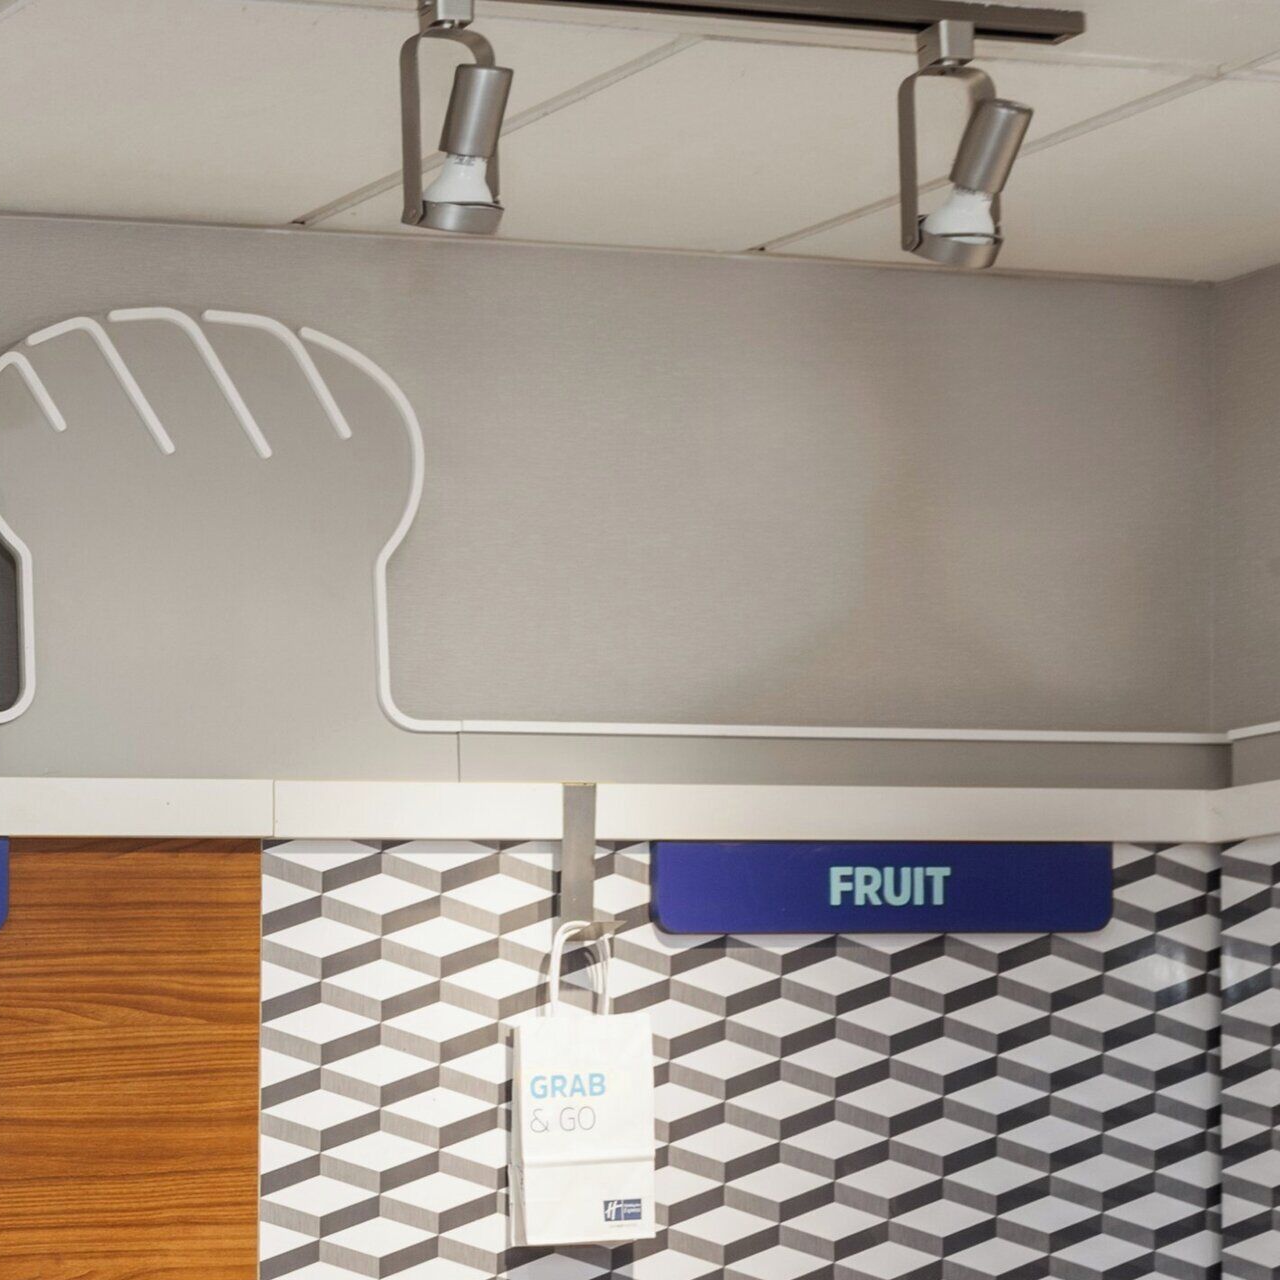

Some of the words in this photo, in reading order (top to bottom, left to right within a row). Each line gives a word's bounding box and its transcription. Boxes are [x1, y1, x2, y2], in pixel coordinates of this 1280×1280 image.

[828, 865, 952, 907] FRUIT
[529, 1072, 607, 1100] GRAB
[530, 1108, 550, 1133] &
[559, 1105, 596, 1132] GO
